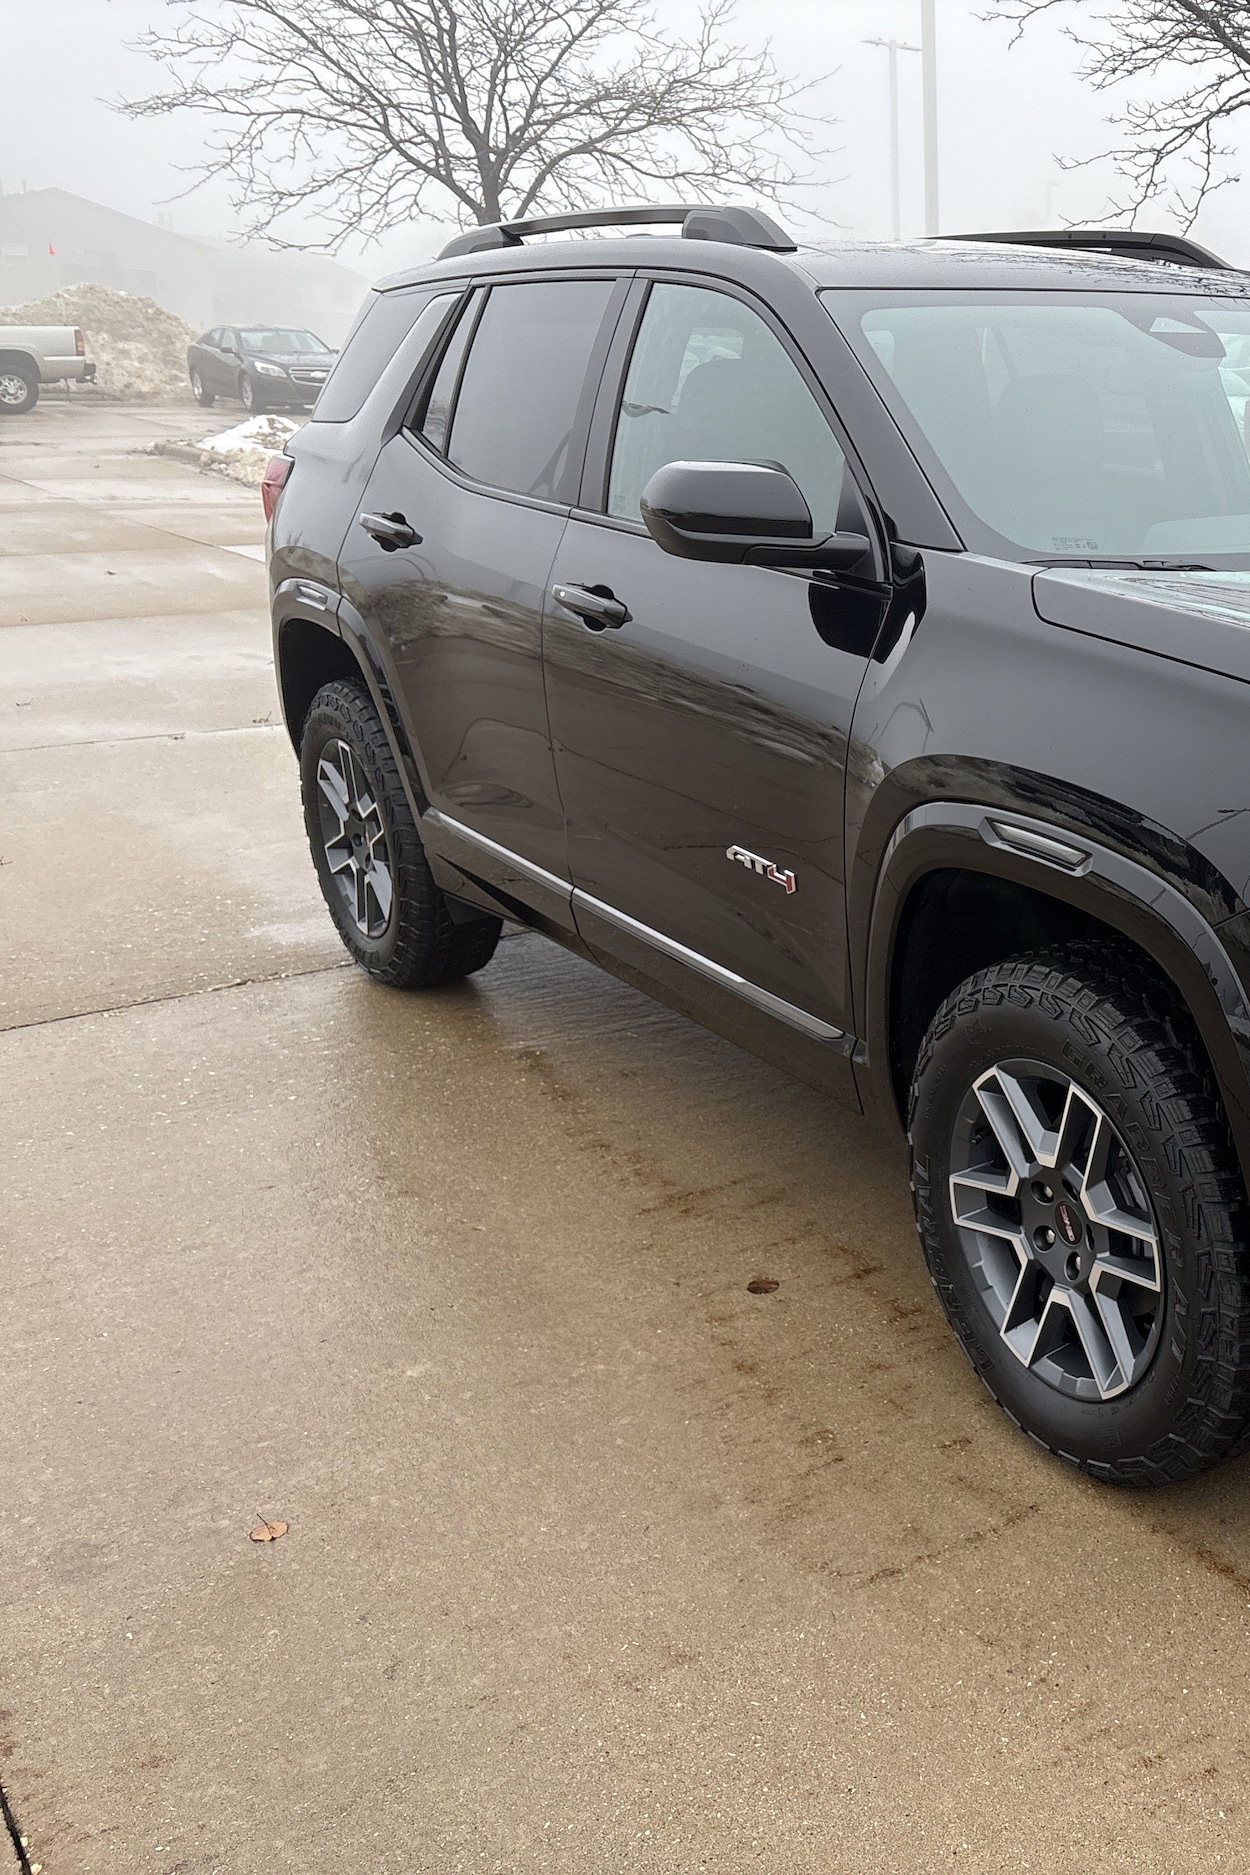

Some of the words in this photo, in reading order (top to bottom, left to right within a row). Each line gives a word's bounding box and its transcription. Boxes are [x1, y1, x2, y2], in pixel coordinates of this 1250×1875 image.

[726, 845, 797, 895] AT4
[1061, 1038, 1187, 1269] GRABBER
[914, 1154, 995, 1362] GENERAL
